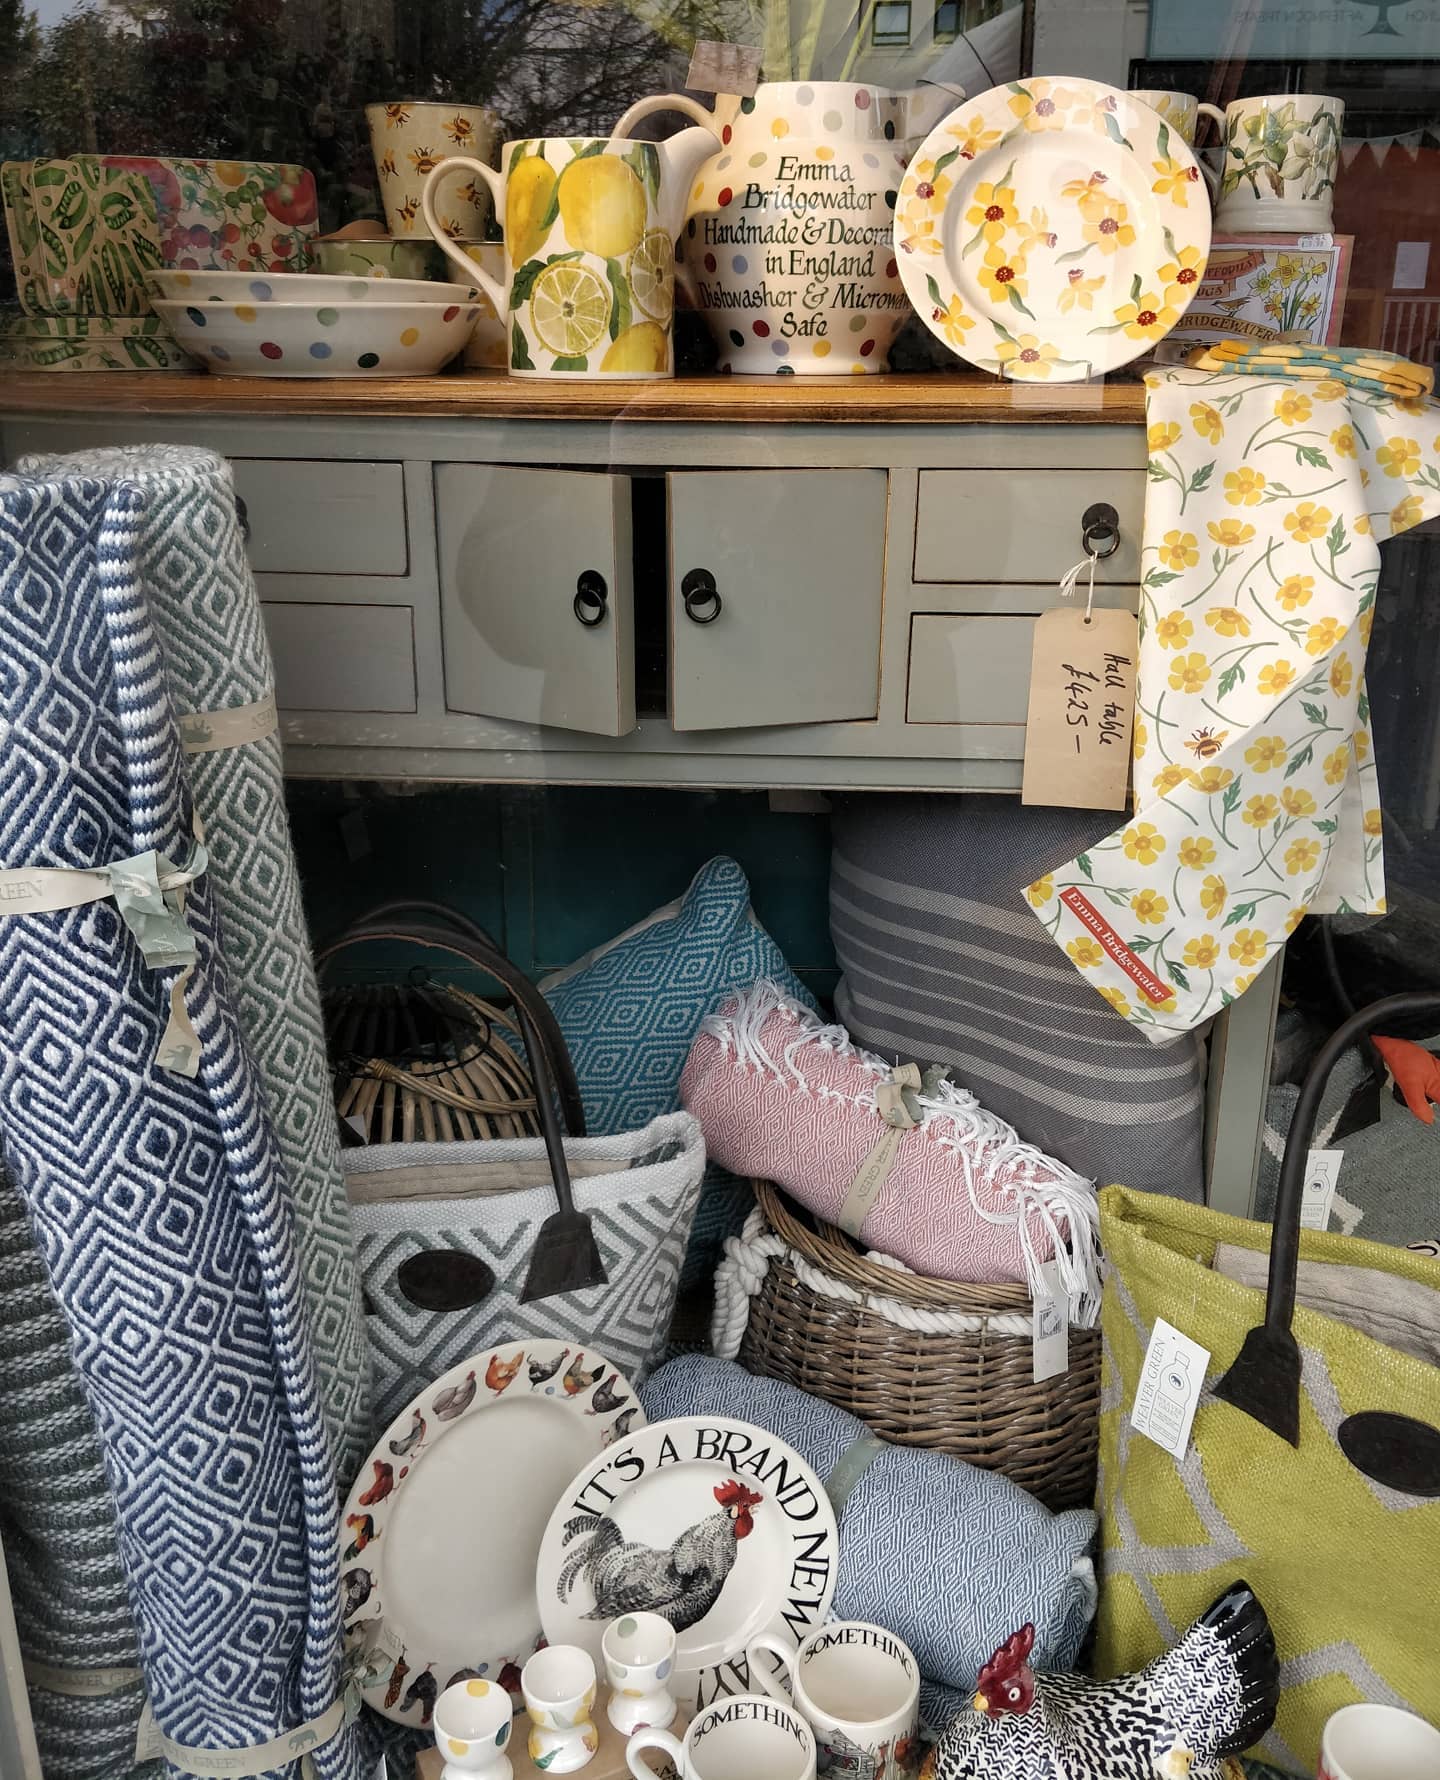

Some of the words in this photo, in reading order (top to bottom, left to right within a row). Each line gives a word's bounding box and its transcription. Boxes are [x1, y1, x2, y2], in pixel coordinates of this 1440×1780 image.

[775, 156, 854, 182] Emma
[742, 183, 877, 219] Bridgewater
[704, 216, 798, 246] Handmade
[801, 216, 826, 245] &
[765, 250, 785, 275] in
[788, 250, 876, 283] England
[697, 281, 797, 308] Dishwasher
[801, 282, 829, 310] &
[780, 312, 828, 338] Safe
[1103, 652, 1131, 689] Hall
[1098, 702, 1125, 745] table
[1067, 892, 1104, 933] Emma
[1102, 932, 1165, 999] Bridgewater
[1135, 1380, 1156, 1428] WEAVER
[1147, 1338, 1166, 1379] GREEN
[572, 1447, 645, 1518] IT'S
[656, 1434, 682, 1468] A
[695, 1428, 819, 1522] BRAND
[780, 1528, 830, 1646] NEW
[804, 1628, 912, 1680] SOMETHING
[693, 1702, 808, 1752] SOMETHING
